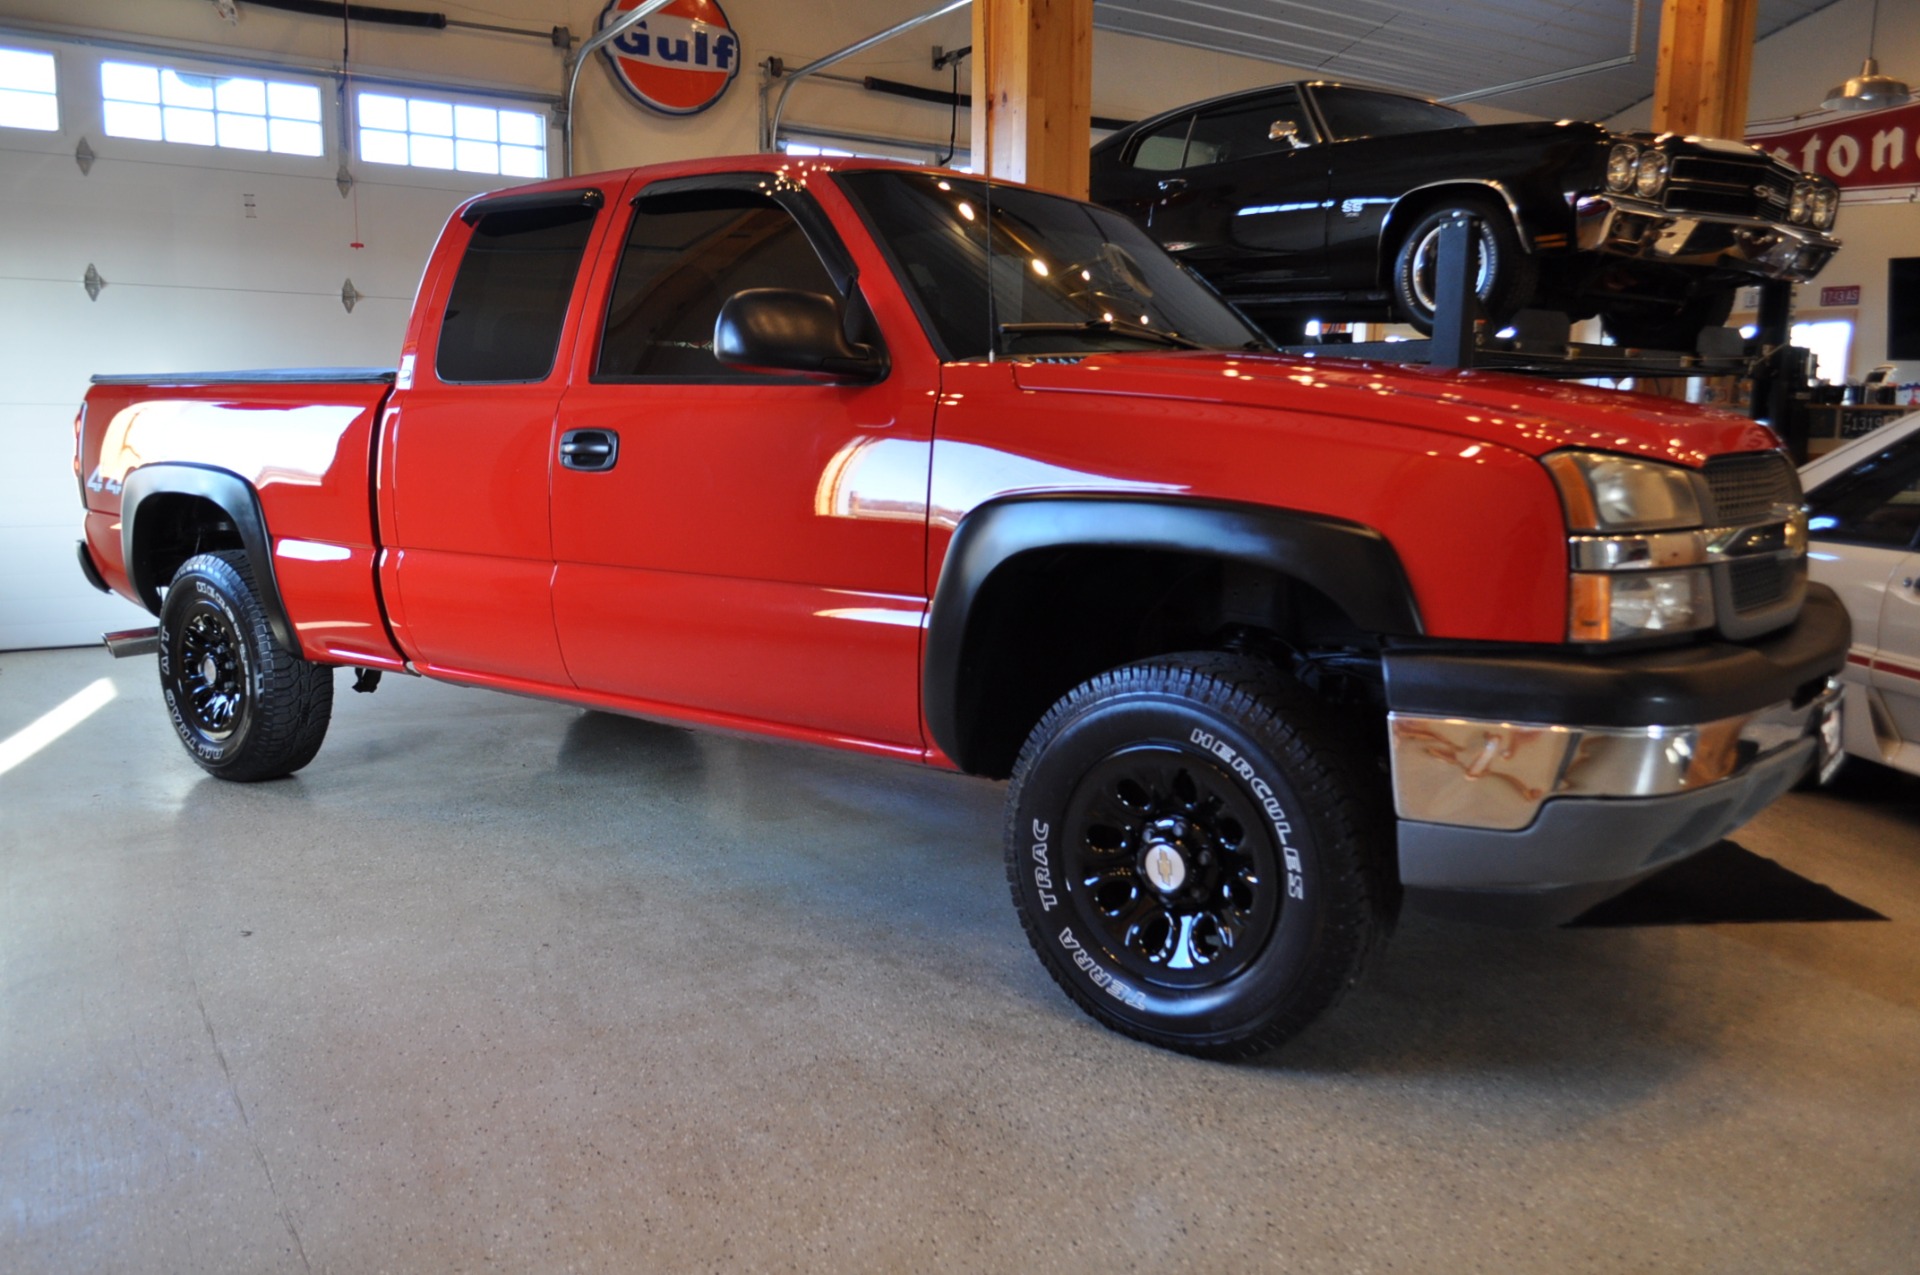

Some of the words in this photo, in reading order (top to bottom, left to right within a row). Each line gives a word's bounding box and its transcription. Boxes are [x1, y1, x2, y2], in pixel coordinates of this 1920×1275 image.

[613, 14, 734, 69] Gulf
[165, 688, 196, 752] TRAC
[1190, 727, 1305, 901] HERCULES
[1032, 818, 1060, 912] TRAC
[1058, 926, 1147, 1012] TERRA
